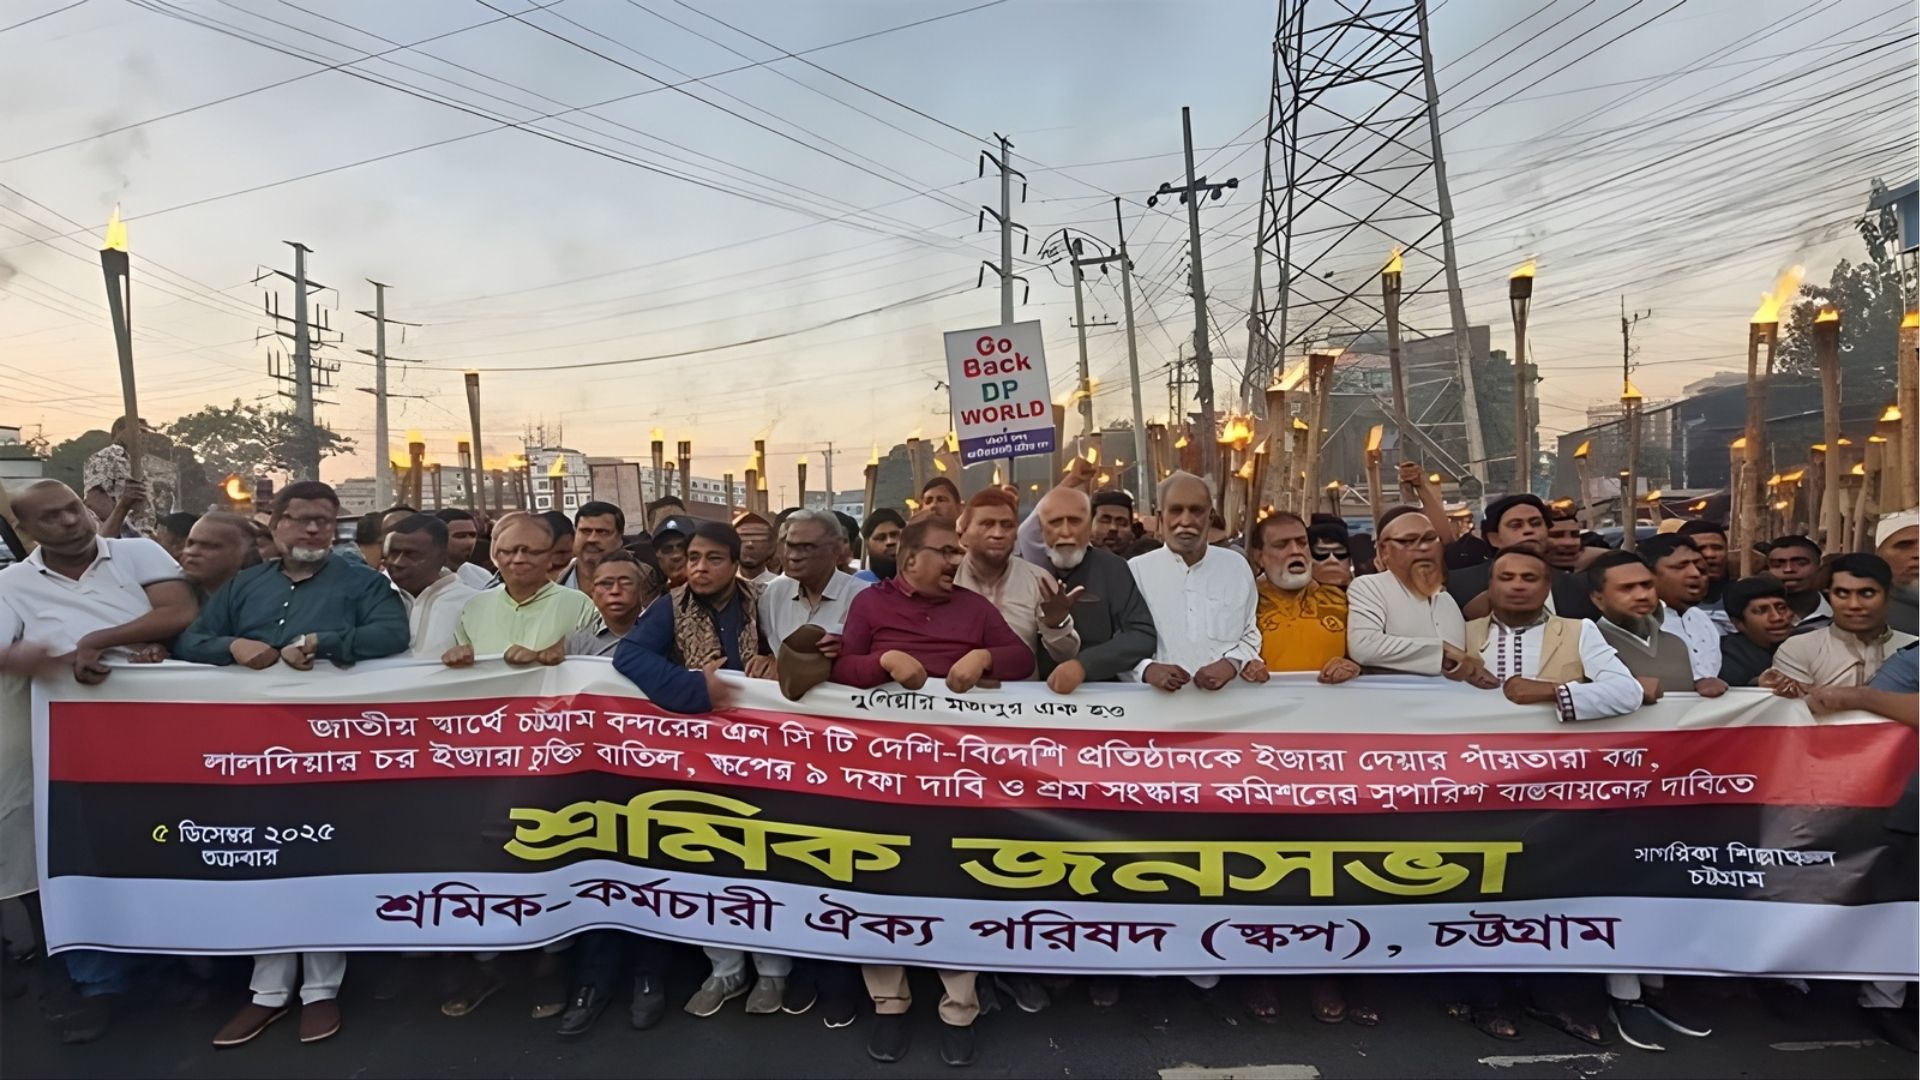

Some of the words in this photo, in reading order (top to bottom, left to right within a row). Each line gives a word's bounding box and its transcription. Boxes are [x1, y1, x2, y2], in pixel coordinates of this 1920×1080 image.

[976, 335, 1012, 356] Go
[963, 352, 1032, 378] Back
[981, 379, 1018, 402] DP
[960, 400, 1045, 425] WORLD
[306, 711, 419, 739] জাতীয়
[427, 704, 509, 734] স্বার্থে
[515, 707, 596, 733] চট্টগ্রাম
[604, 711, 712, 740] বন্দরের
[722, 722, 770, 746] এন
[779, 720, 814, 750] সি
[823, 725, 859, 753] টি
[869, 732, 1067, 768] দেশি-বিদেশি
[1077, 738, 1243, 769] প্রতিষ্ঠানকে
[1251, 743, 1347, 771] ইজারা
[1359, 750, 1448, 771] দেয়ার
[1460, 744, 1592, 770] পাঁয়তারা
[202, 746, 361, 776] লালদিয়ার
[370, 749, 419, 769] চর
[429, 740, 523, 768] ইজারা
[529, 737, 584, 772] চুক্তি
[806, 763, 829, 785] ৯
[839, 766, 907, 795] দফা
[915, 769, 987, 799] দাবি
[999, 779, 1025, 798] ও
[1036, 777, 1092, 800] শ্রম
[1097, 781, 1202, 805] সংস্কার
[1210, 776, 1358, 806] কমিশনের
[1366, 776, 1488, 810] সুপারিশ
[1496, 780, 1653, 802] বাস্তবায়নের
[1662, 769, 1759, 797] দাবিতে
[152, 825, 169, 843] ৫
[178, 819, 256, 844] ডিসেম্বর
[264, 823, 335, 844] ২০২৫
[505, 790, 911, 882] শ্রমিক
[952, 837, 1523, 897] জনসভা
[805, 893, 945, 947] ঐক্য
[970, 909, 1177, 953] পরিষদ
[1428, 909, 1622, 951] চট্টগ্রাম
